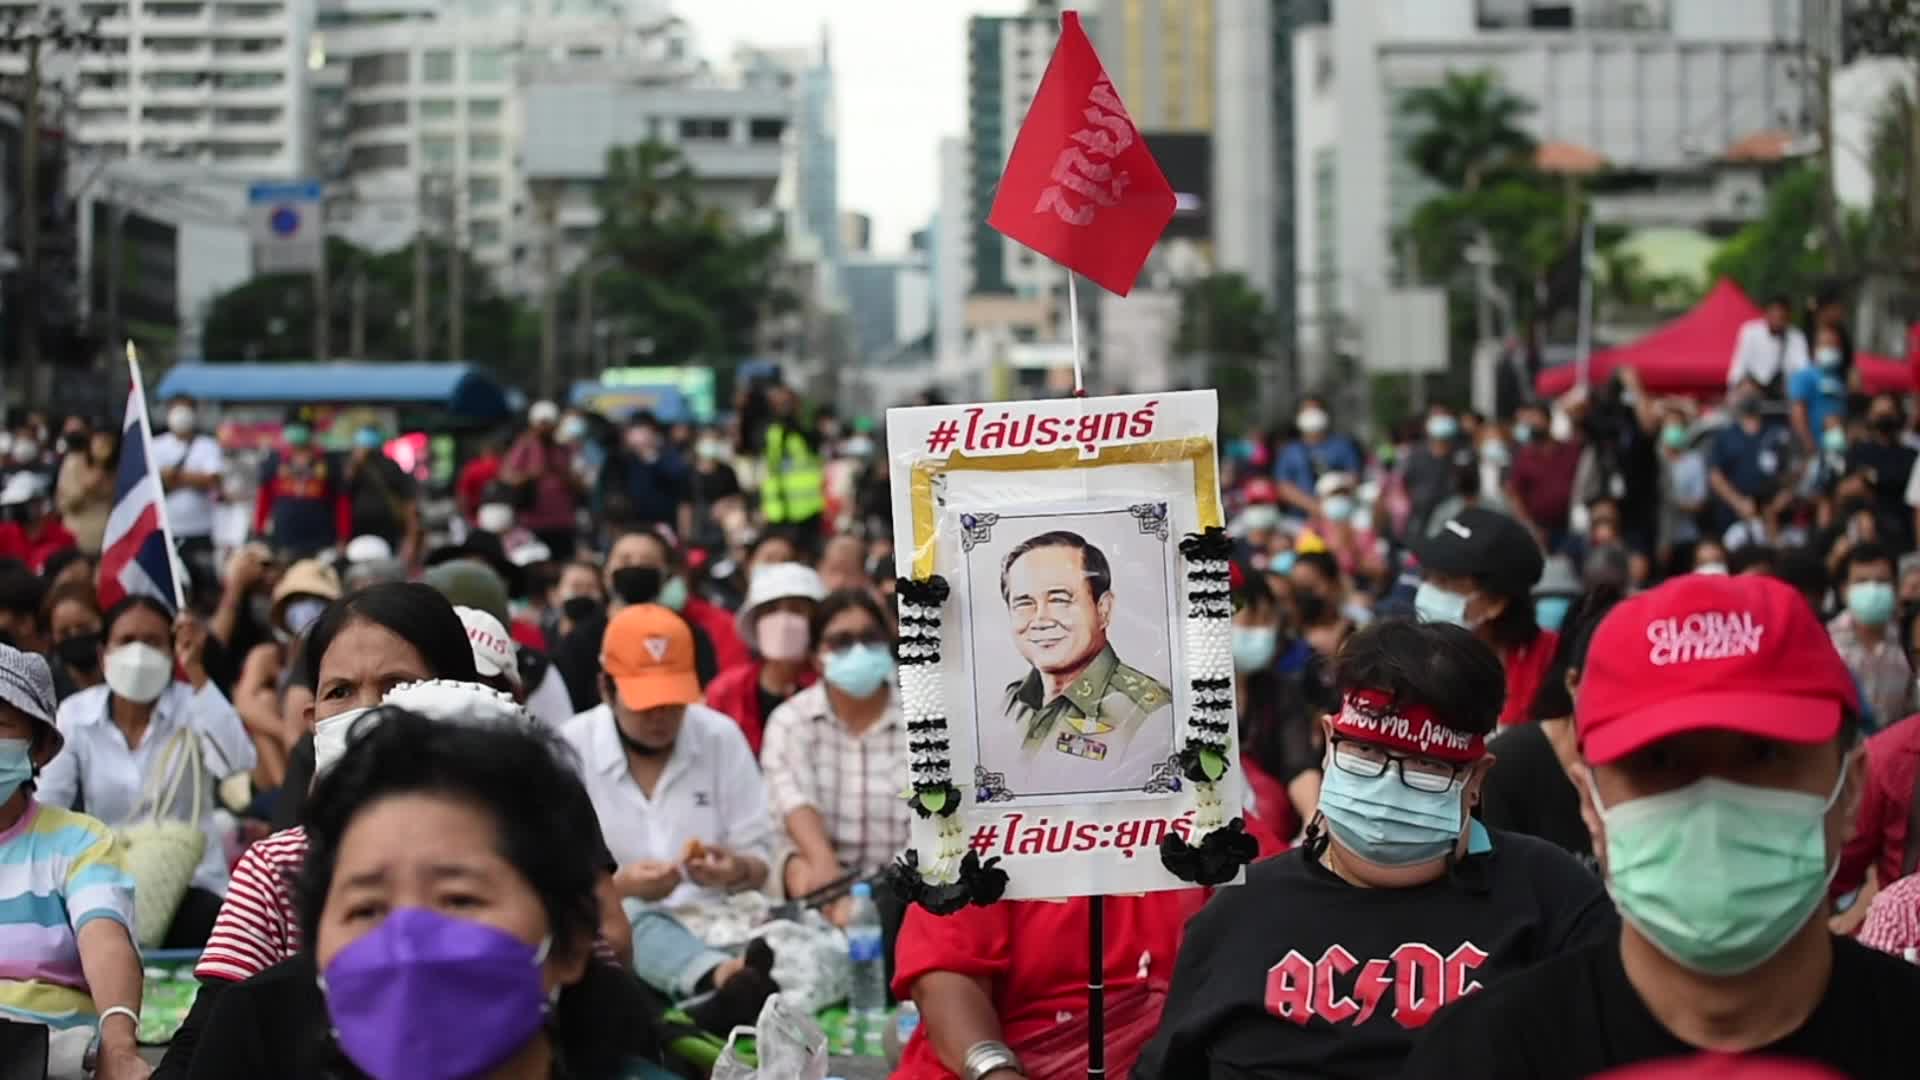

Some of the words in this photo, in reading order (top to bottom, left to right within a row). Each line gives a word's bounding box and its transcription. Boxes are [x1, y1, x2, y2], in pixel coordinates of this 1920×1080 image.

[926, 401, 1159, 453] #ไล่ประยุทธ์
[1646, 609, 1757, 645] GLOBAL
[1649, 623, 1765, 666] CITIZEN
